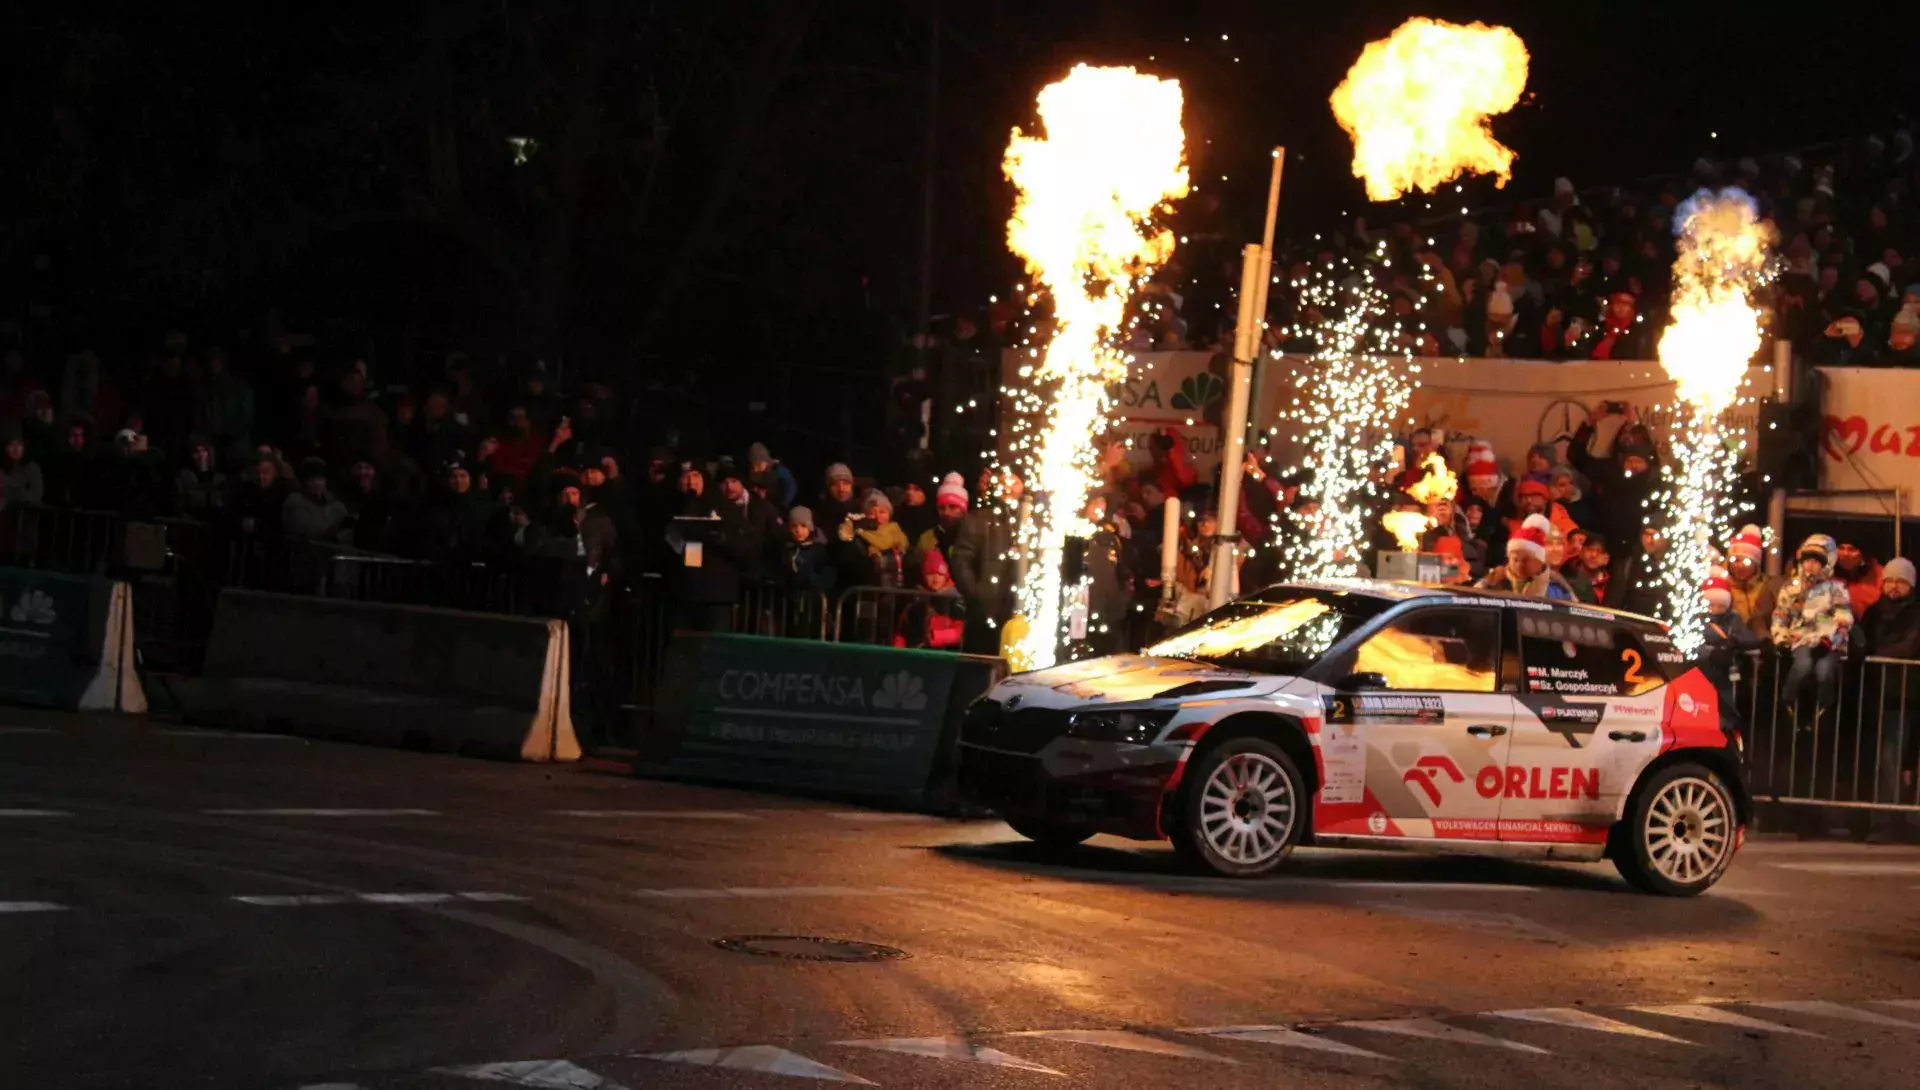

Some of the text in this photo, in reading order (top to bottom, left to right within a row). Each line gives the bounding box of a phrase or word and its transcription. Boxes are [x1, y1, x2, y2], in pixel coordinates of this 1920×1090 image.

[1537, 667, 1588, 680] M. Marczyk
[1621, 648, 1646, 685] 2
[718, 669, 866, 709] COMPENSA
[1540, 681, 1618, 694] Sz. Gospodarczyk
[1332, 700, 1345, 719] 2
[1556, 708, 1599, 718] PLATINUM
[1475, 765, 1600, 801] ORLEN
[1436, 820, 1584, 834] VOLKSWAGEN FINANCIAL SERVICES
